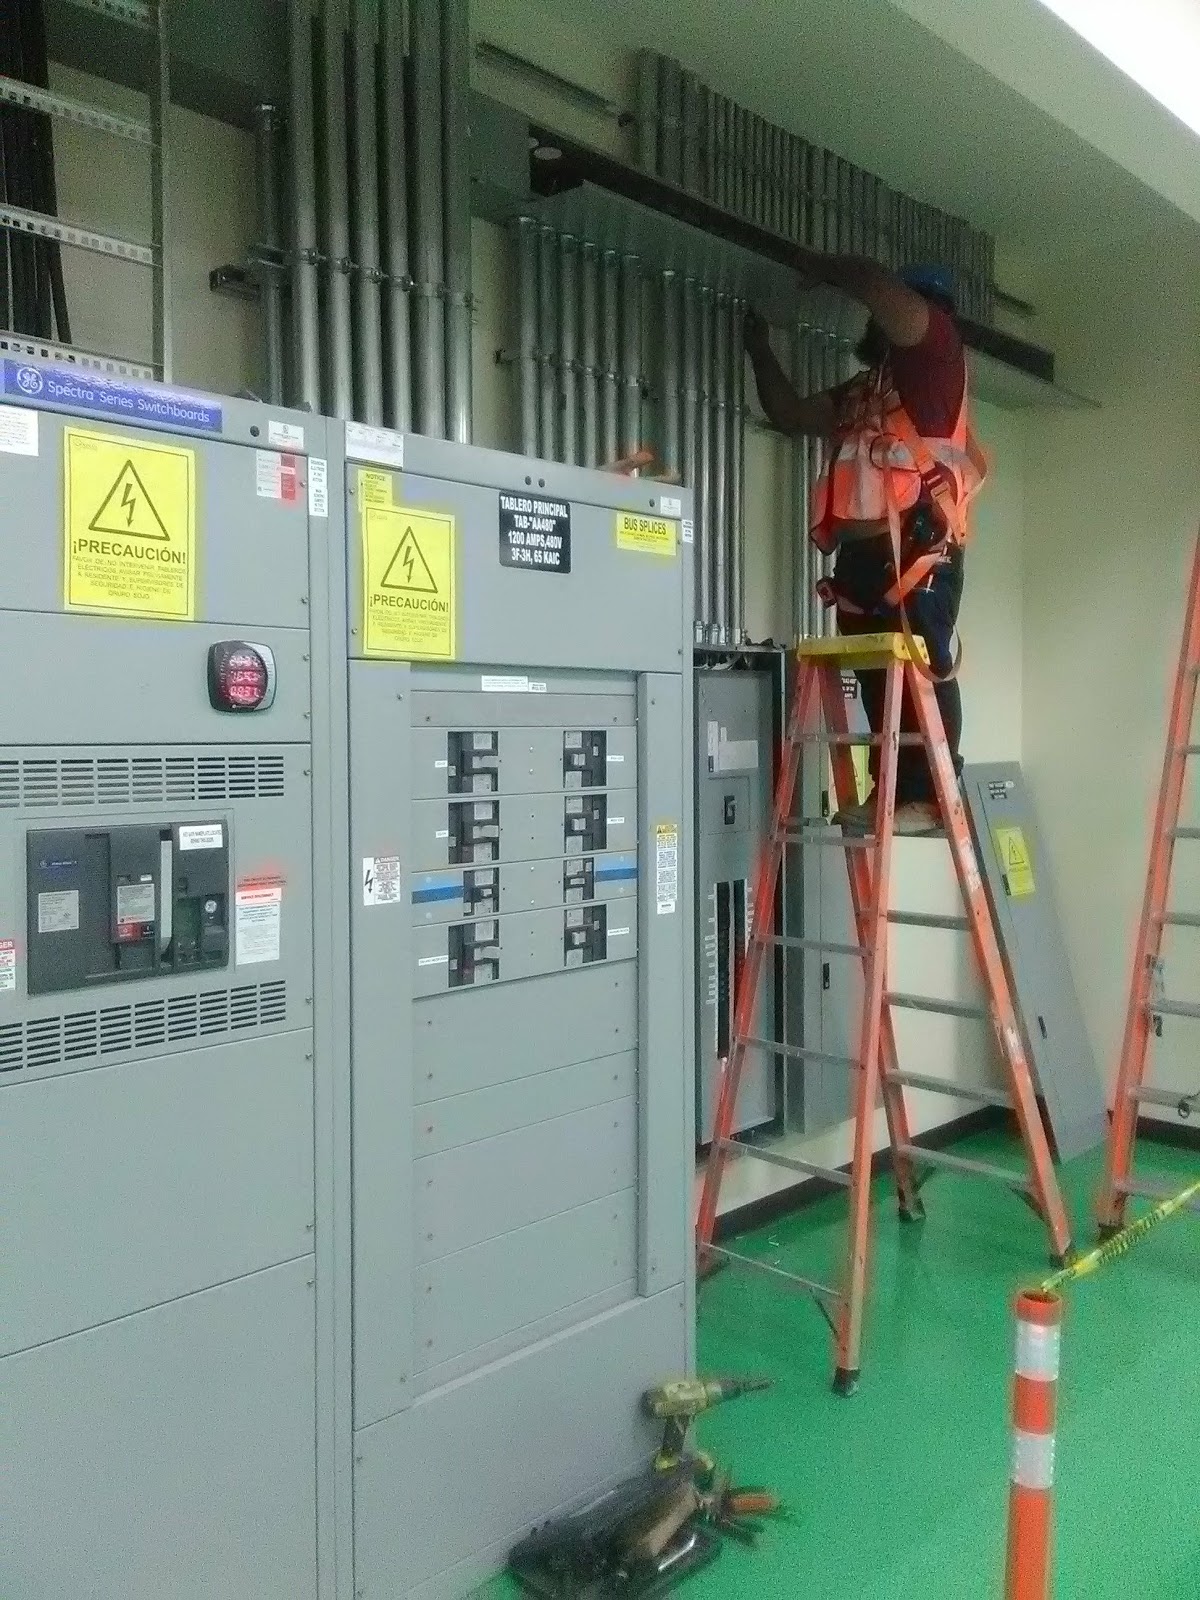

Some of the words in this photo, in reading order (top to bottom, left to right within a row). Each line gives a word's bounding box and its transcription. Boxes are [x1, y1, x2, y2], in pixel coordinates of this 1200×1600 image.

[48, 380, 94, 400] Spectra
[100, 391, 134, 408] Series
[138, 399, 210, 422] Switchboards
[501, 495, 532, 513] TABLERO
[533, 500, 568, 518] PRINCIPAL
[624, 517, 637, 531] BUS
[639, 519, 666, 535] SPLICES
[508, 530, 525, 545] 1200
[73, 538, 186, 564] ¡PRECAUCIÓN!
[533, 549, 542, 563] 65
[543, 550, 560, 565] KAIC
[369, 594, 449, 612] ¡PRECAUCIÓN!
